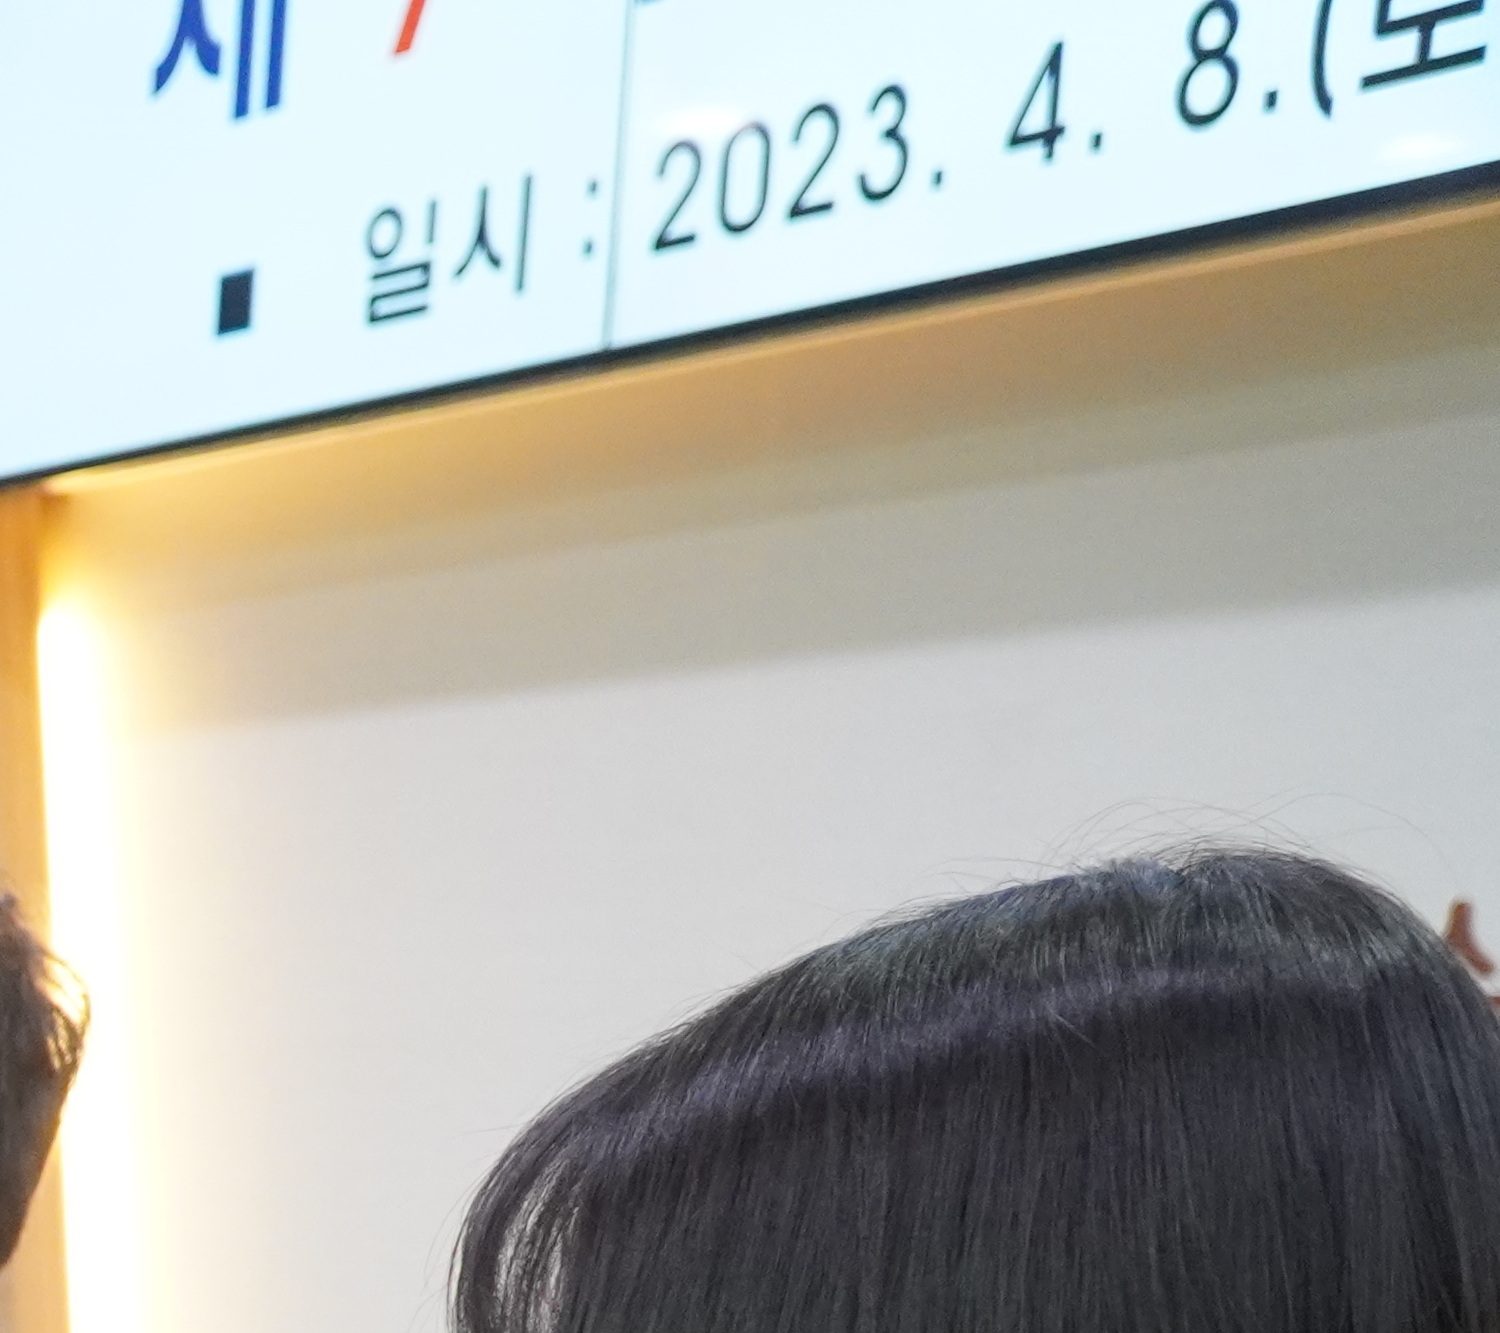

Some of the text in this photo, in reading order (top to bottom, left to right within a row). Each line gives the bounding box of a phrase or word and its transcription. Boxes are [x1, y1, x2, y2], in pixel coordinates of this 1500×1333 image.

[366, 175, 532, 324] 일시
[651, 83, 944, 253] 2023.
[1005, 41, 1105, 162] 4.
